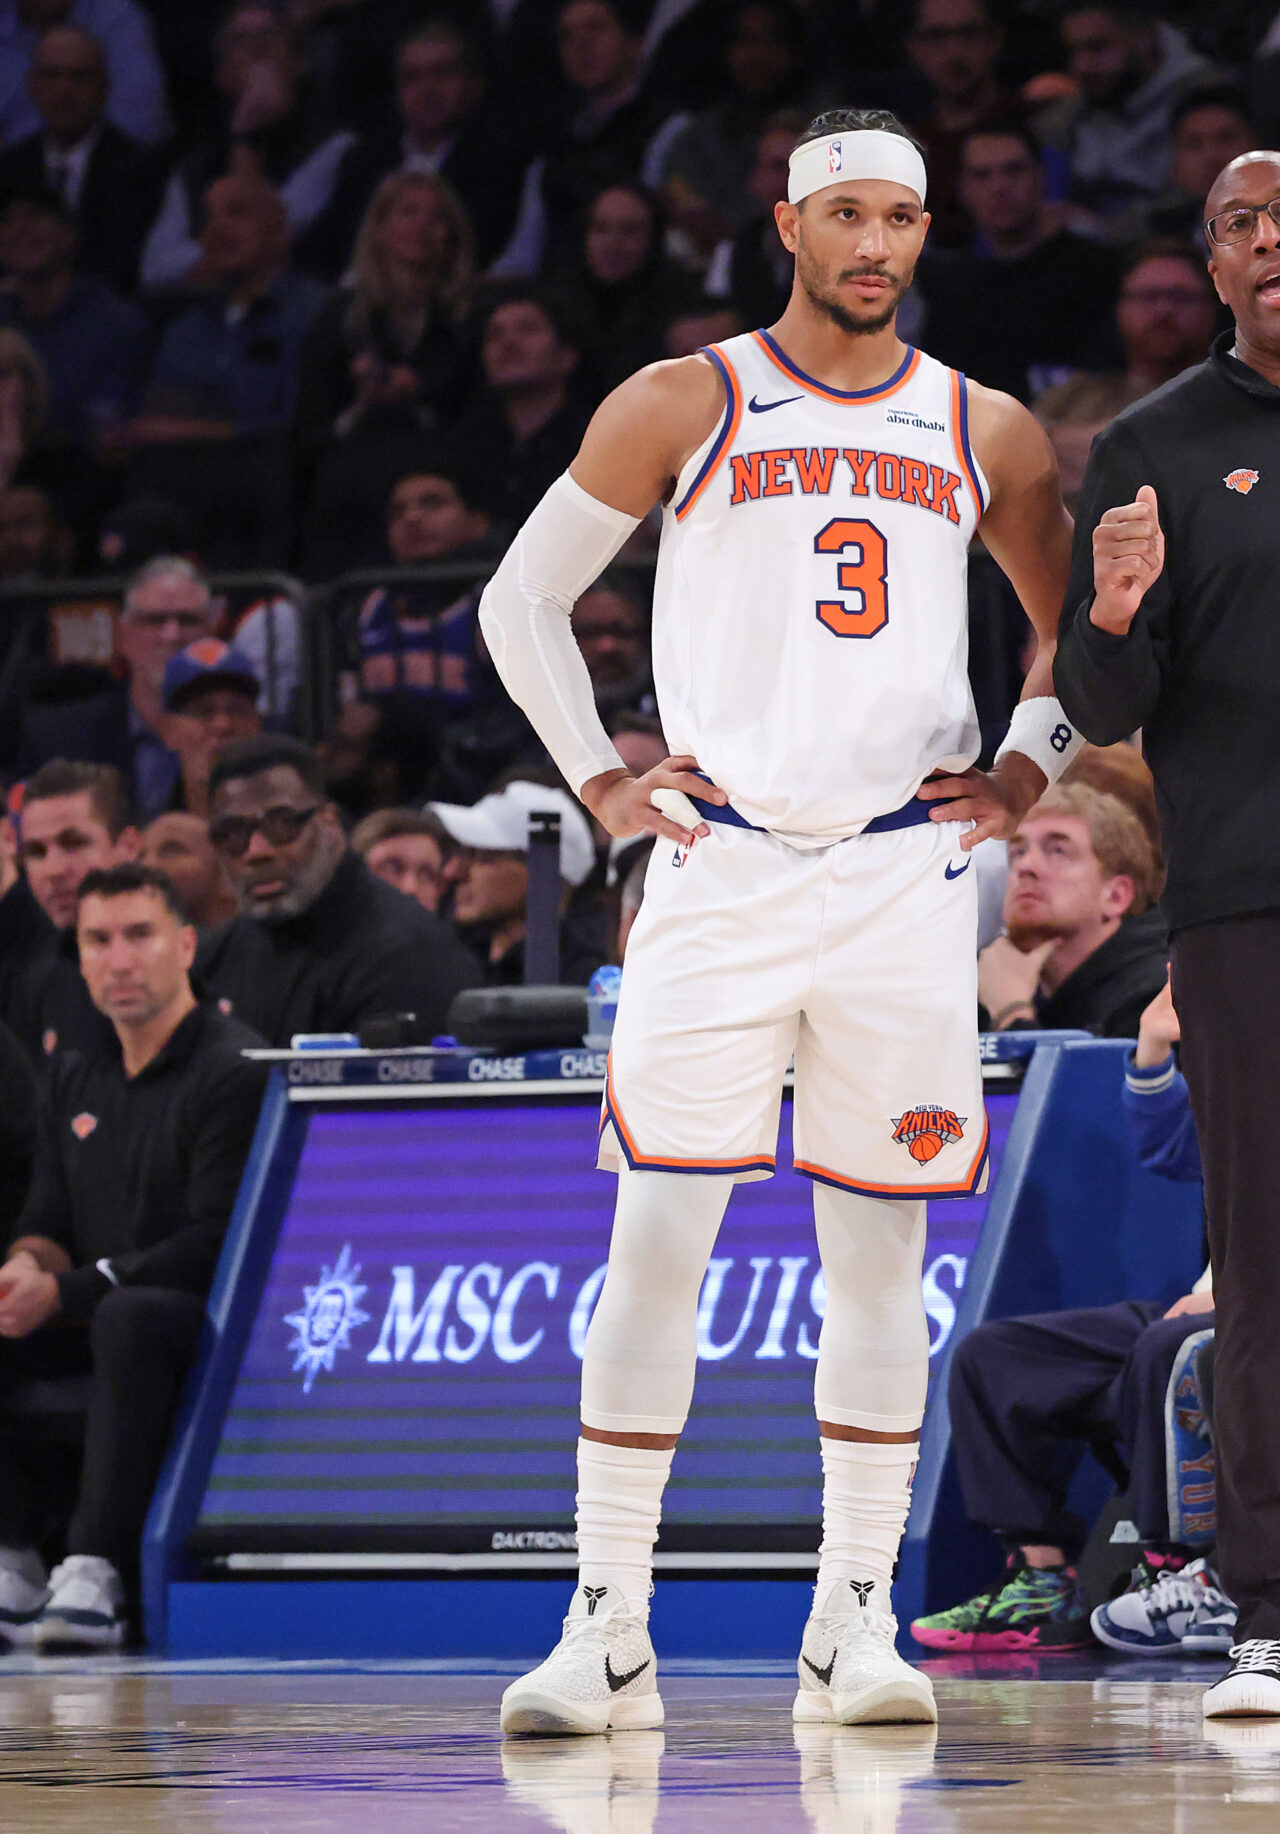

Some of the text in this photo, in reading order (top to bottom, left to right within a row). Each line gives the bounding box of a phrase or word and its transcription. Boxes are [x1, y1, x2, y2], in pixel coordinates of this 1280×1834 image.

[887, 415, 945, 432] abu dhabi
[730, 447, 961, 527] NEW YORK
[814, 517, 889, 639] 3
[1050, 723, 1072, 753] 8
[288, 1060, 345, 1084] CHASE
[378, 1059, 434, 1083] CHASE
[468, 1057, 526, 1080] CHASE
[560, 1054, 607, 1078] CHAS
[891, 1110, 963, 1138] KNICKS
[366, 1253, 968, 1364] MSC CUIS
[491, 1531, 578, 1549] DAKTRONI
